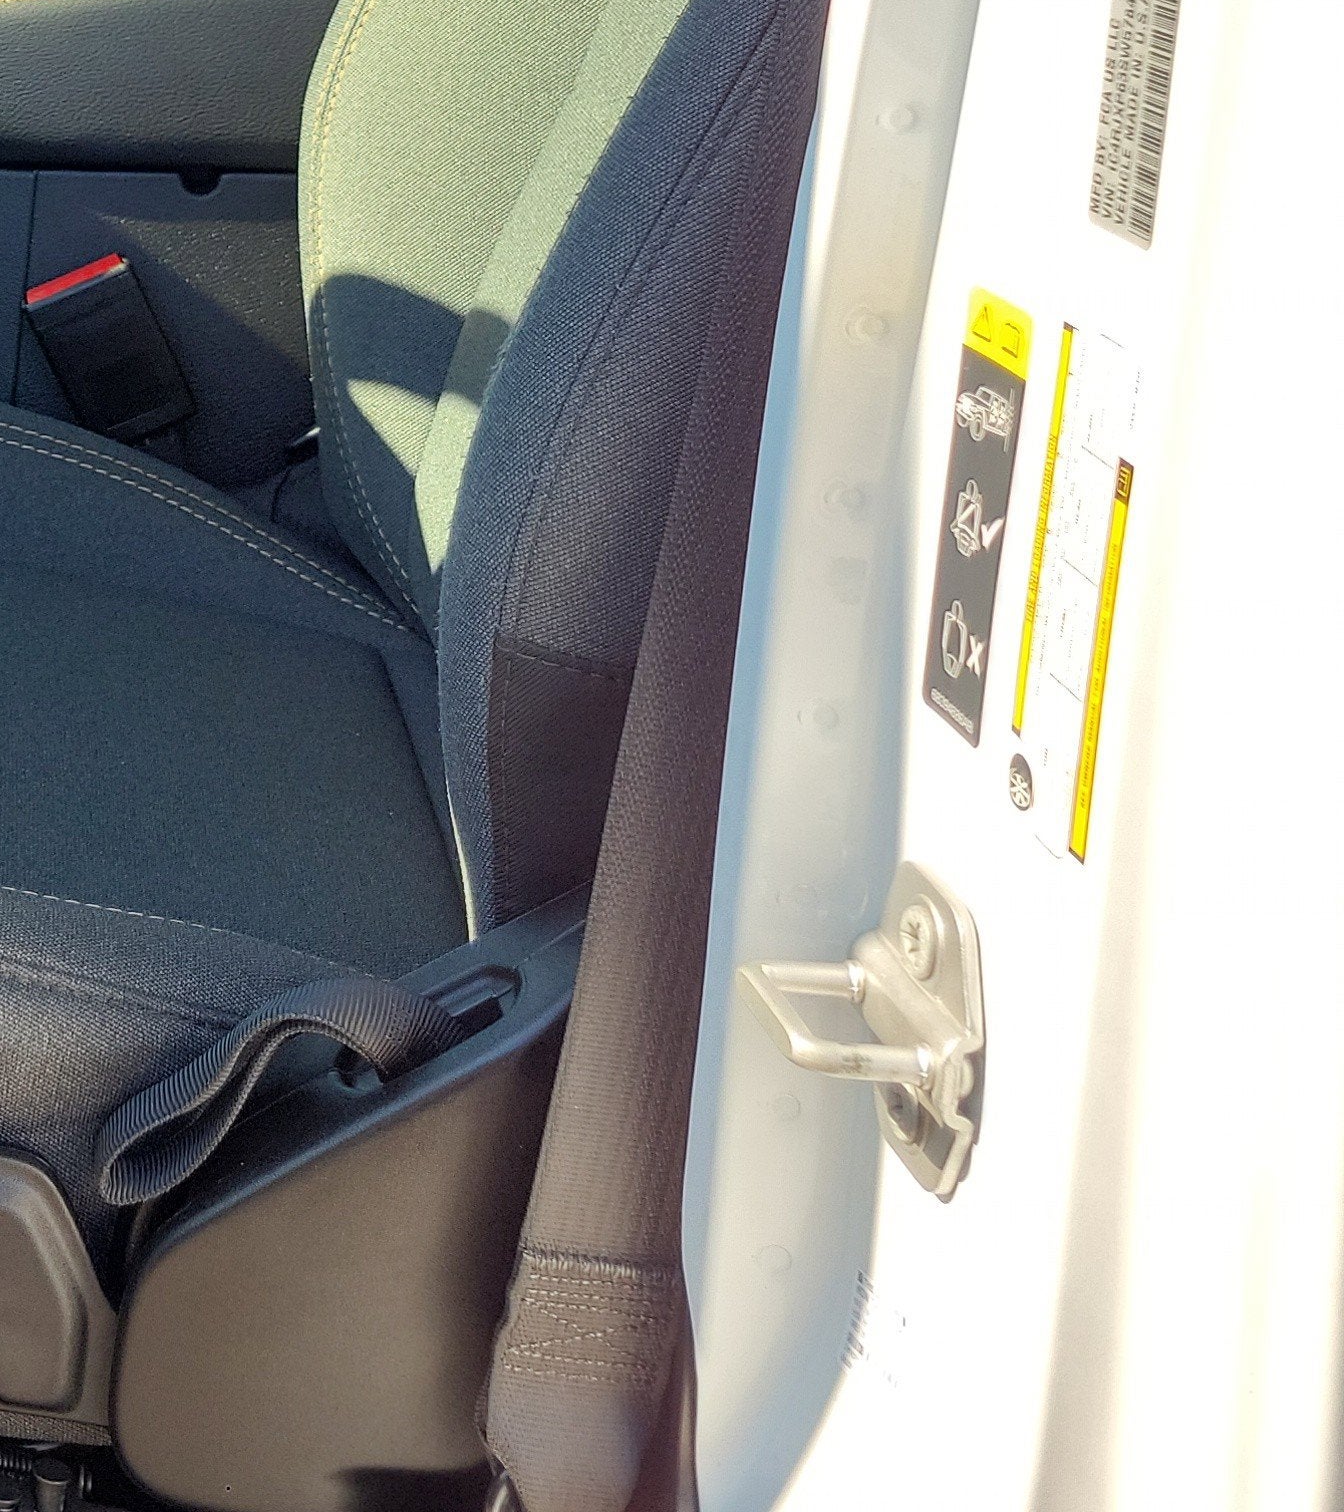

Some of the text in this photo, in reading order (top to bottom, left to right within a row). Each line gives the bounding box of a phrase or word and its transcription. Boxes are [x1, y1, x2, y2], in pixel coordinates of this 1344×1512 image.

[1129, 50, 1143, 80] IN:
[1088, 16, 1120, 216] MFD BY: FCA US LLC
[1122, 84, 1139, 142] MADE
[1100, 179, 1115, 222] VIN:
[1112, 144, 1132, 227] VEHICLE
